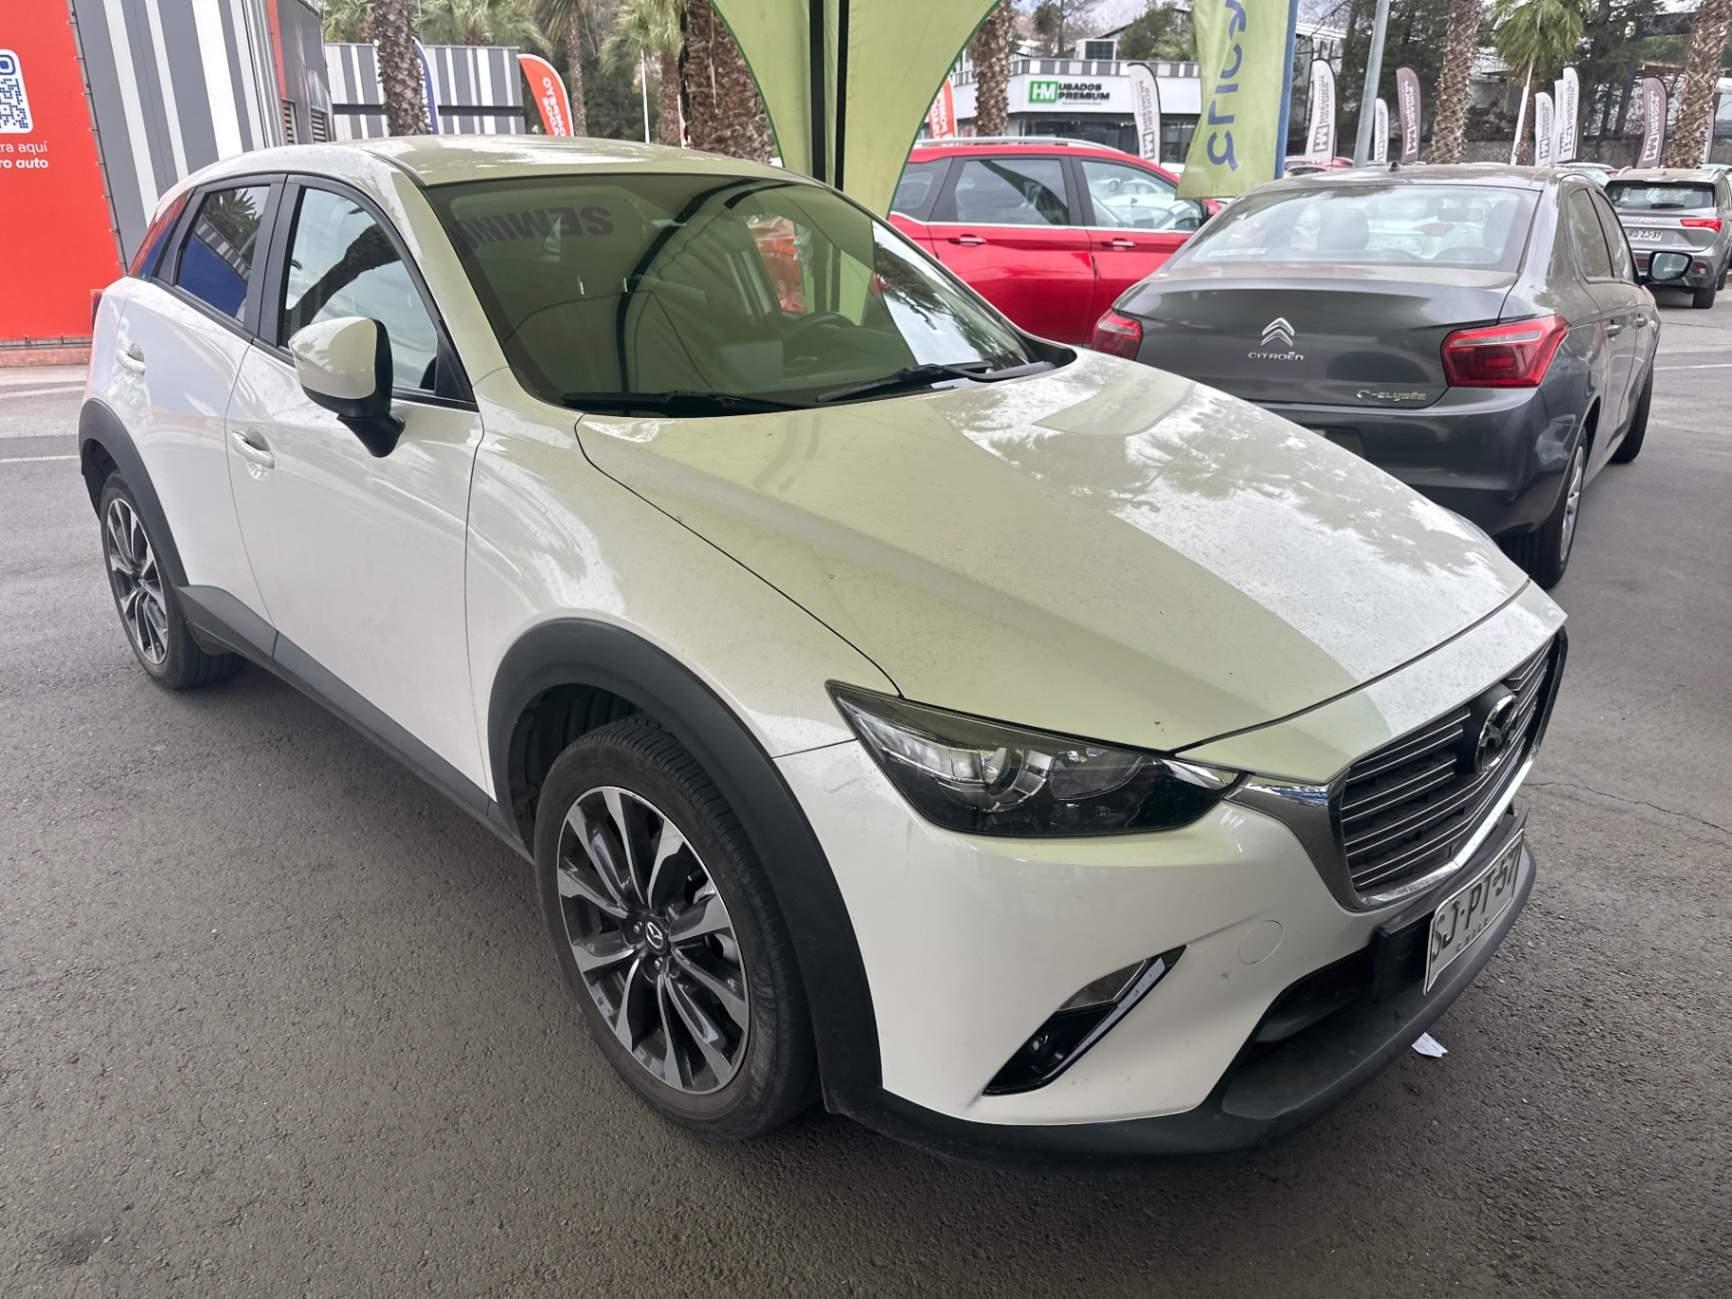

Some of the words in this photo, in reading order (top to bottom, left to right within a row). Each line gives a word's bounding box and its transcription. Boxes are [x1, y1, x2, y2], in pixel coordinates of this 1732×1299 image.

[1031, 82, 1057, 101] HM
[1059, 83, 1102, 91] USADOS
[1059, 92, 1110, 100] PREMIUM
[18, 140, 48, 156] aquí
[16, 157, 48, 168] auto
